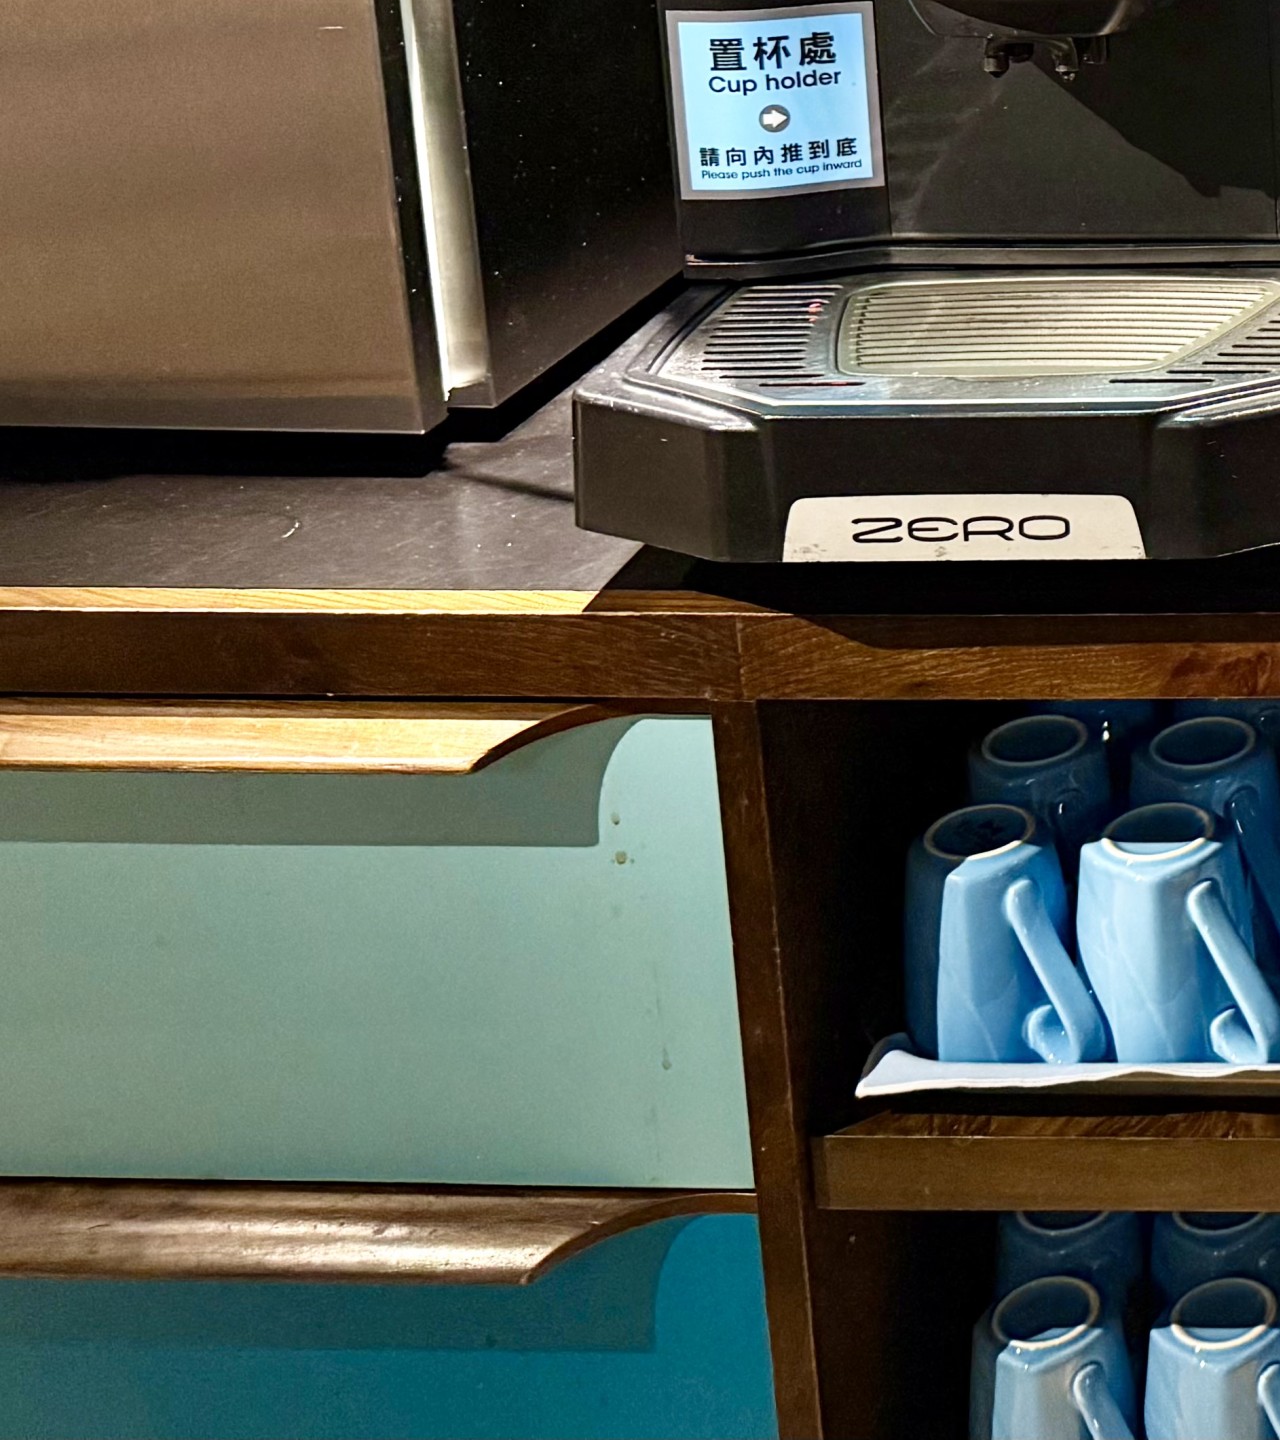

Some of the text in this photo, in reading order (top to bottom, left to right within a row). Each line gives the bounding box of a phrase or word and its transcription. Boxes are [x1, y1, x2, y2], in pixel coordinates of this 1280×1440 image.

[709, 32, 837, 72] 置杯處
[709, 70, 841, 96] Cup holder
[700, 137, 857, 167] 請向內推到底
[701, 159, 862, 180] Please push the cup inward
[851, 515, 1070, 543] ZERO
